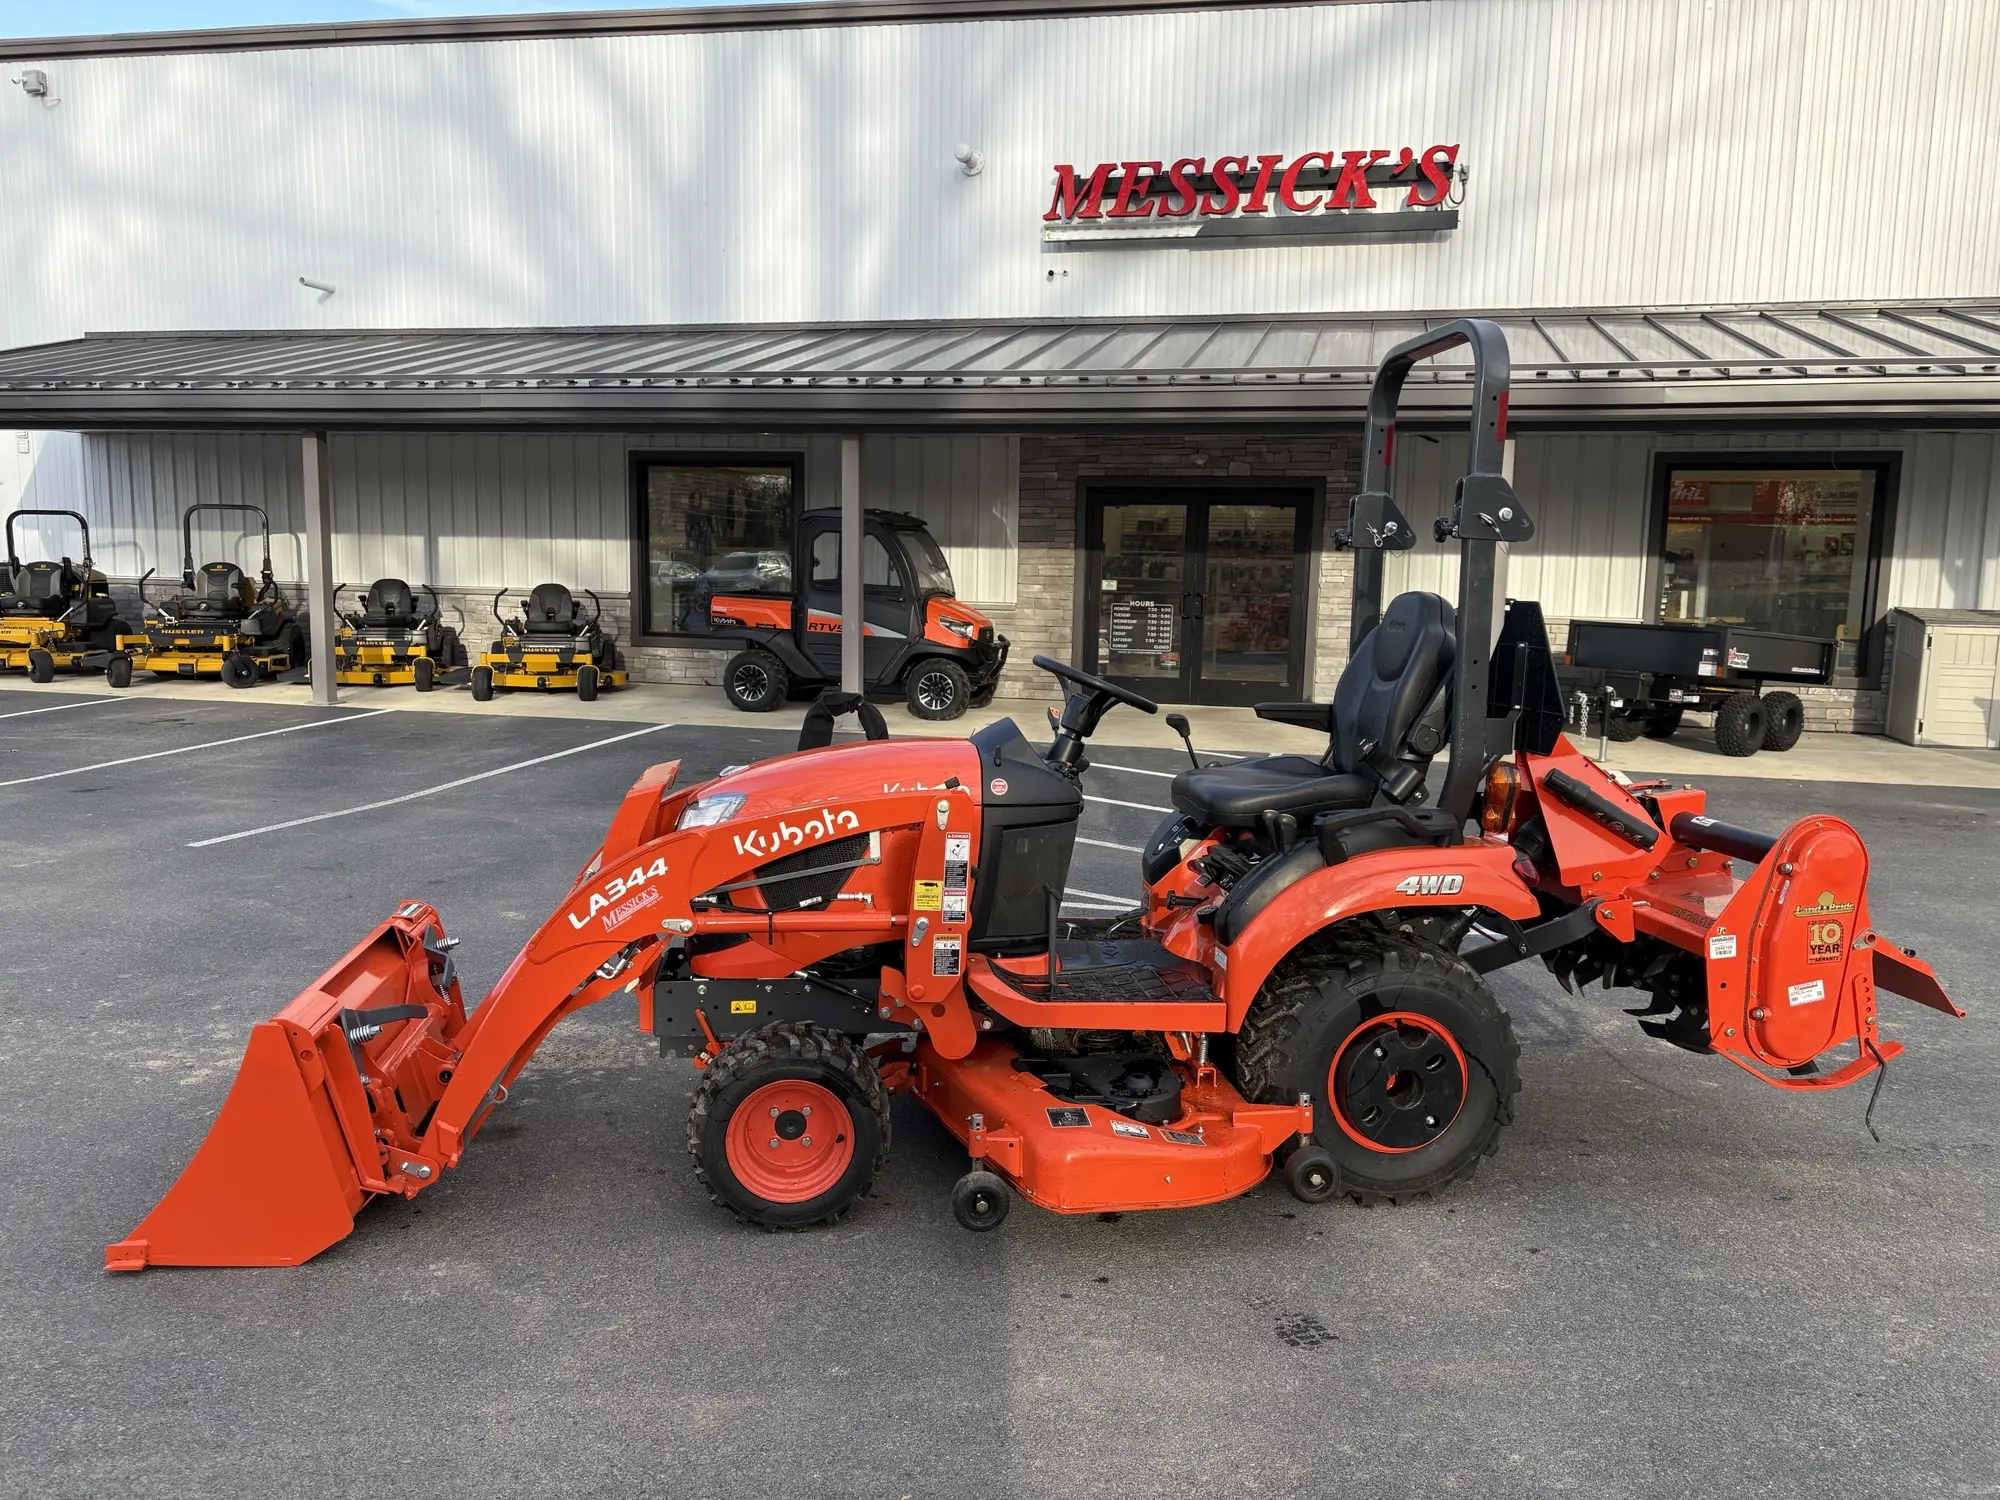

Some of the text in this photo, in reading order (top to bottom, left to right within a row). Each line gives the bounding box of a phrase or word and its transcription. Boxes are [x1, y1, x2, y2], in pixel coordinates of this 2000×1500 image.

[1042, 144, 1461, 221] MESSICK'S
[733, 808, 861, 858] Kubota
[568, 857, 669, 930] LA344
[1395, 873, 1465, 896] 4WD
[1809, 922, 1841, 945] 10
[1809, 944, 1841, 955] YEAR
